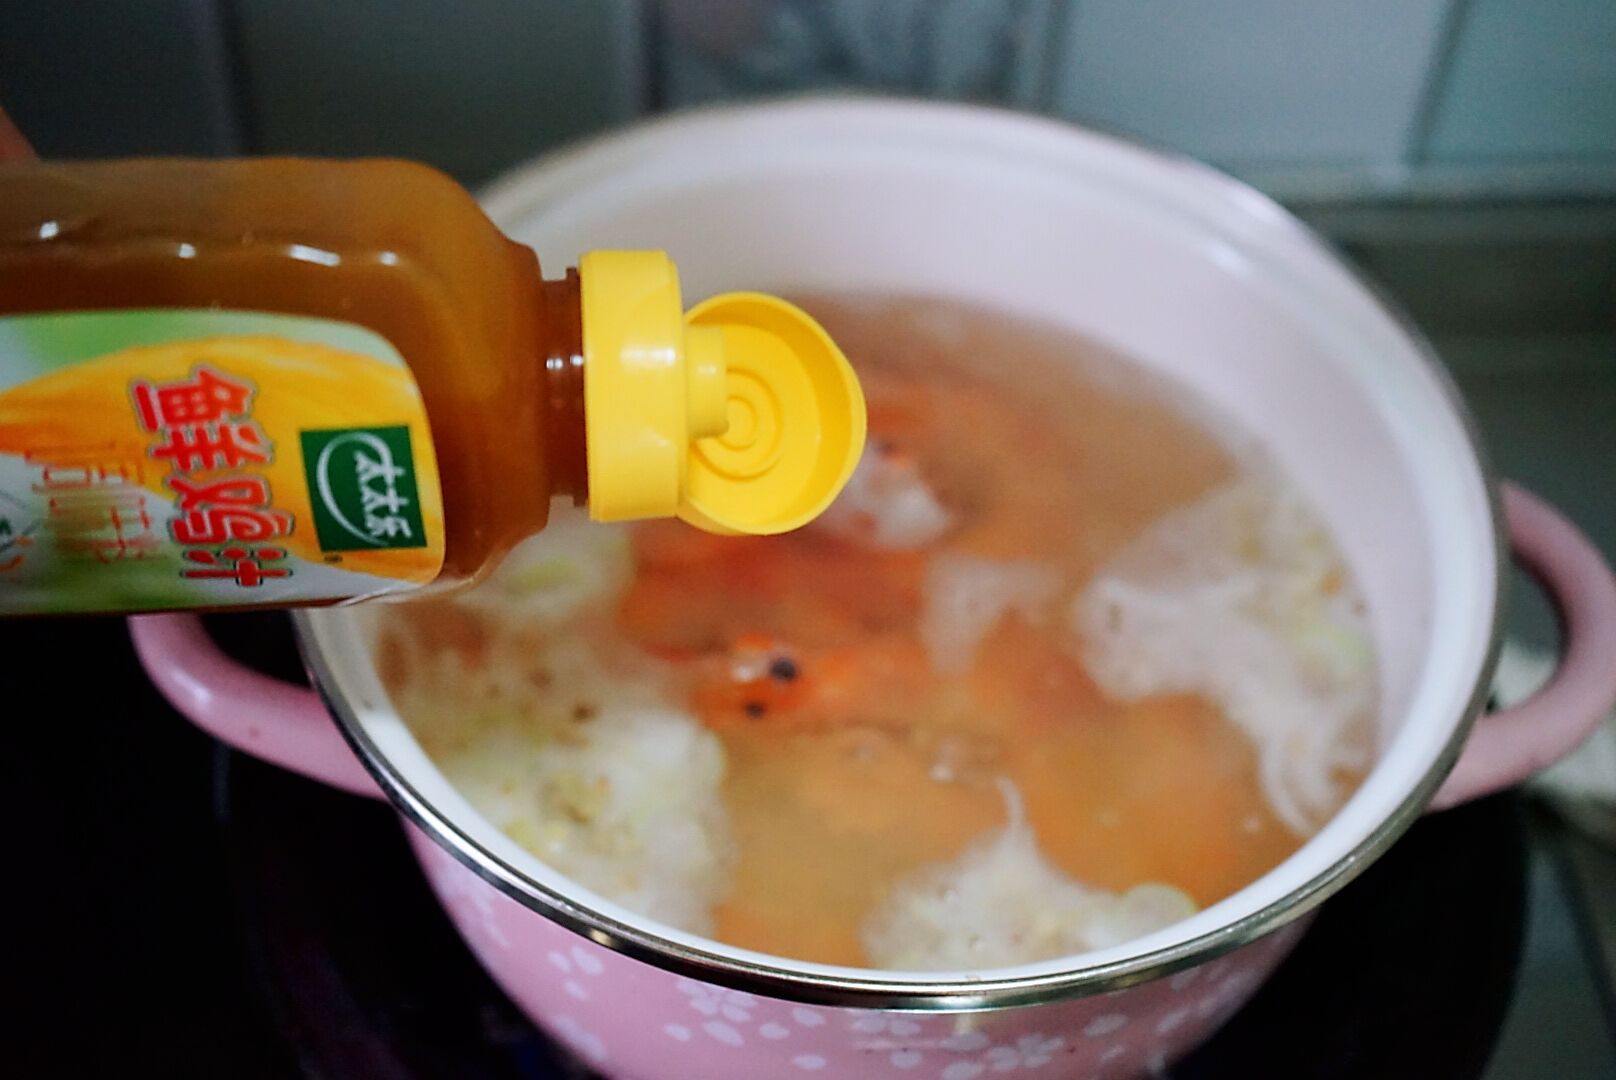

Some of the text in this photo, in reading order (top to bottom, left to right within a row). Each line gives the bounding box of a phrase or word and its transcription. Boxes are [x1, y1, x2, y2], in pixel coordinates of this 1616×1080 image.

[130, 365, 293, 587] 鲜鸡汁
[352, 444, 412, 541] 太太乐
